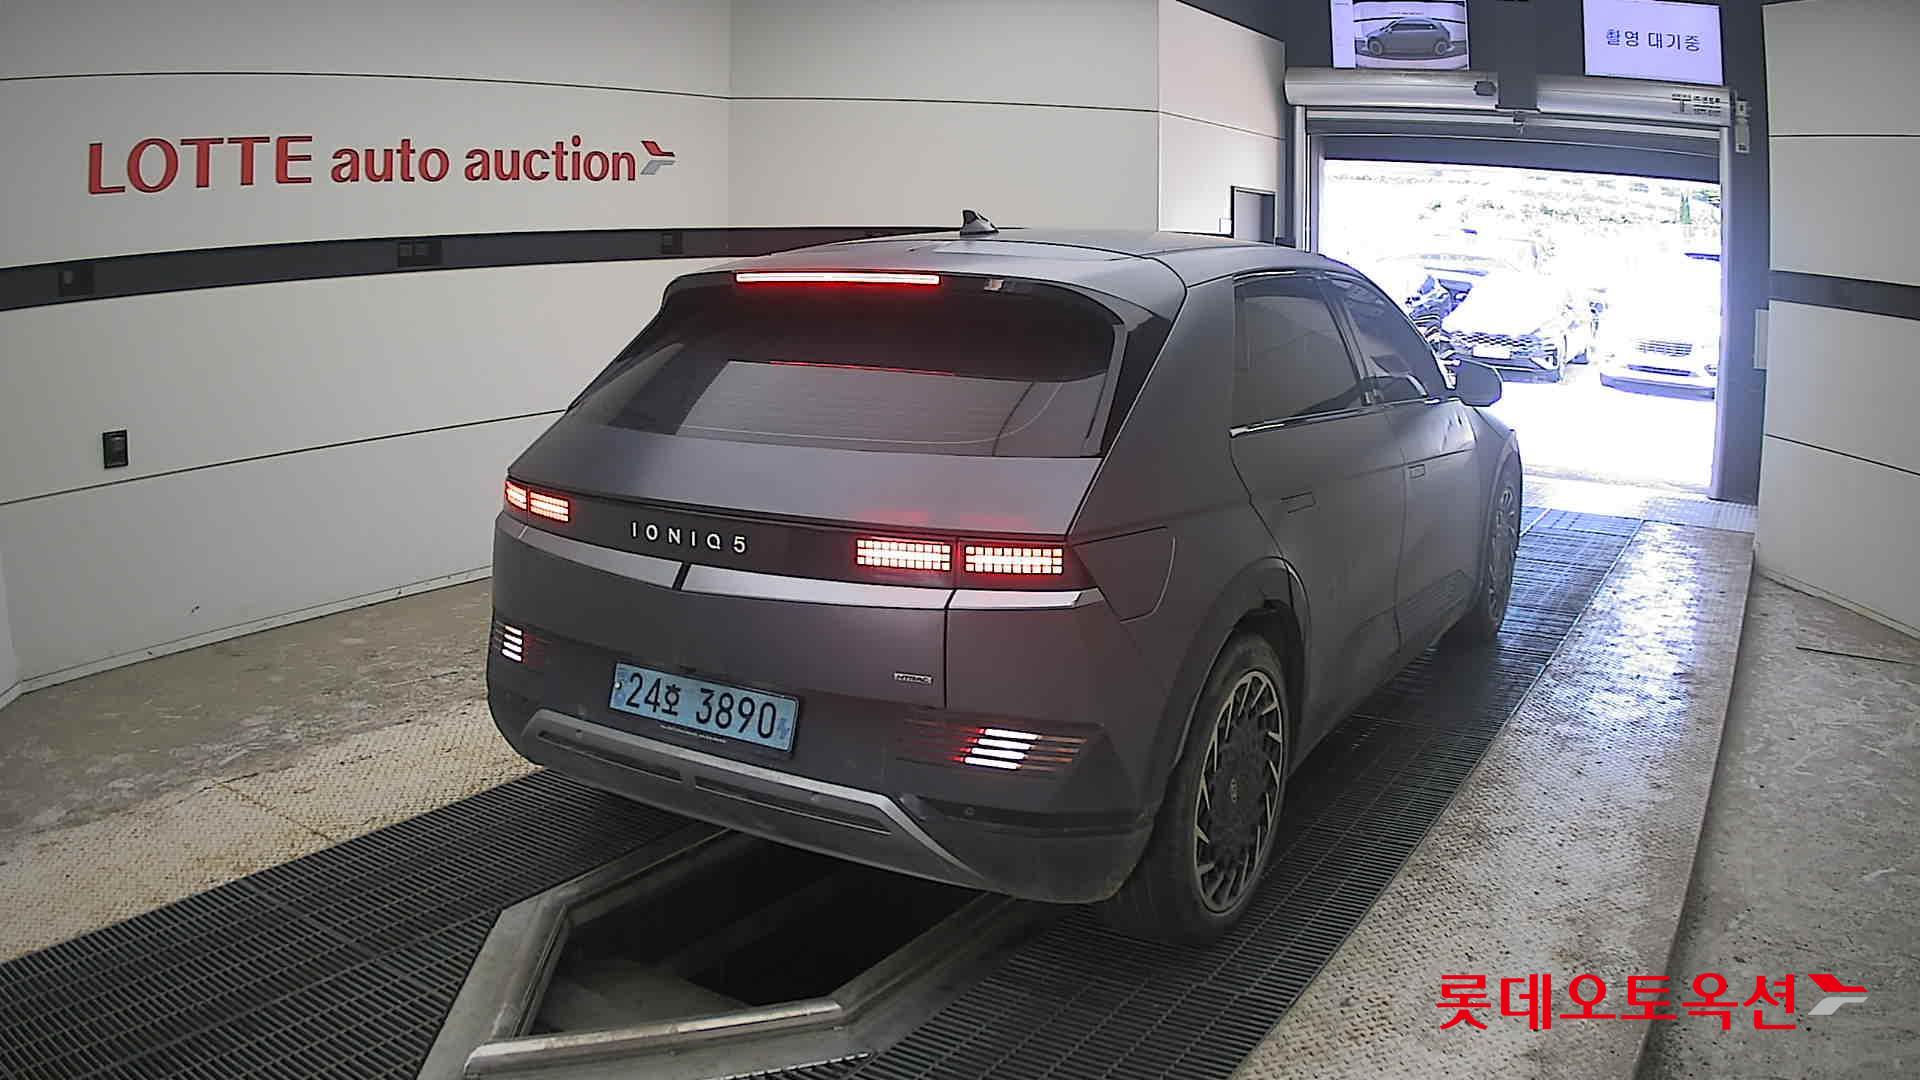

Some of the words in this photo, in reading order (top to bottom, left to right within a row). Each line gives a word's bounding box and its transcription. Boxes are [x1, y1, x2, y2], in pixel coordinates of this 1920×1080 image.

[1647, 32, 1701, 51] 대기중
[89, 136, 313, 194] LOTTE
[331, 139, 450, 182] auto
[465, 136, 637, 182] auction
[631, 521, 721, 550] IONIQ
[733, 535, 746, 553] 5
[625, 672, 681, 717] 24호
[695, 687, 777, 739] 3890
